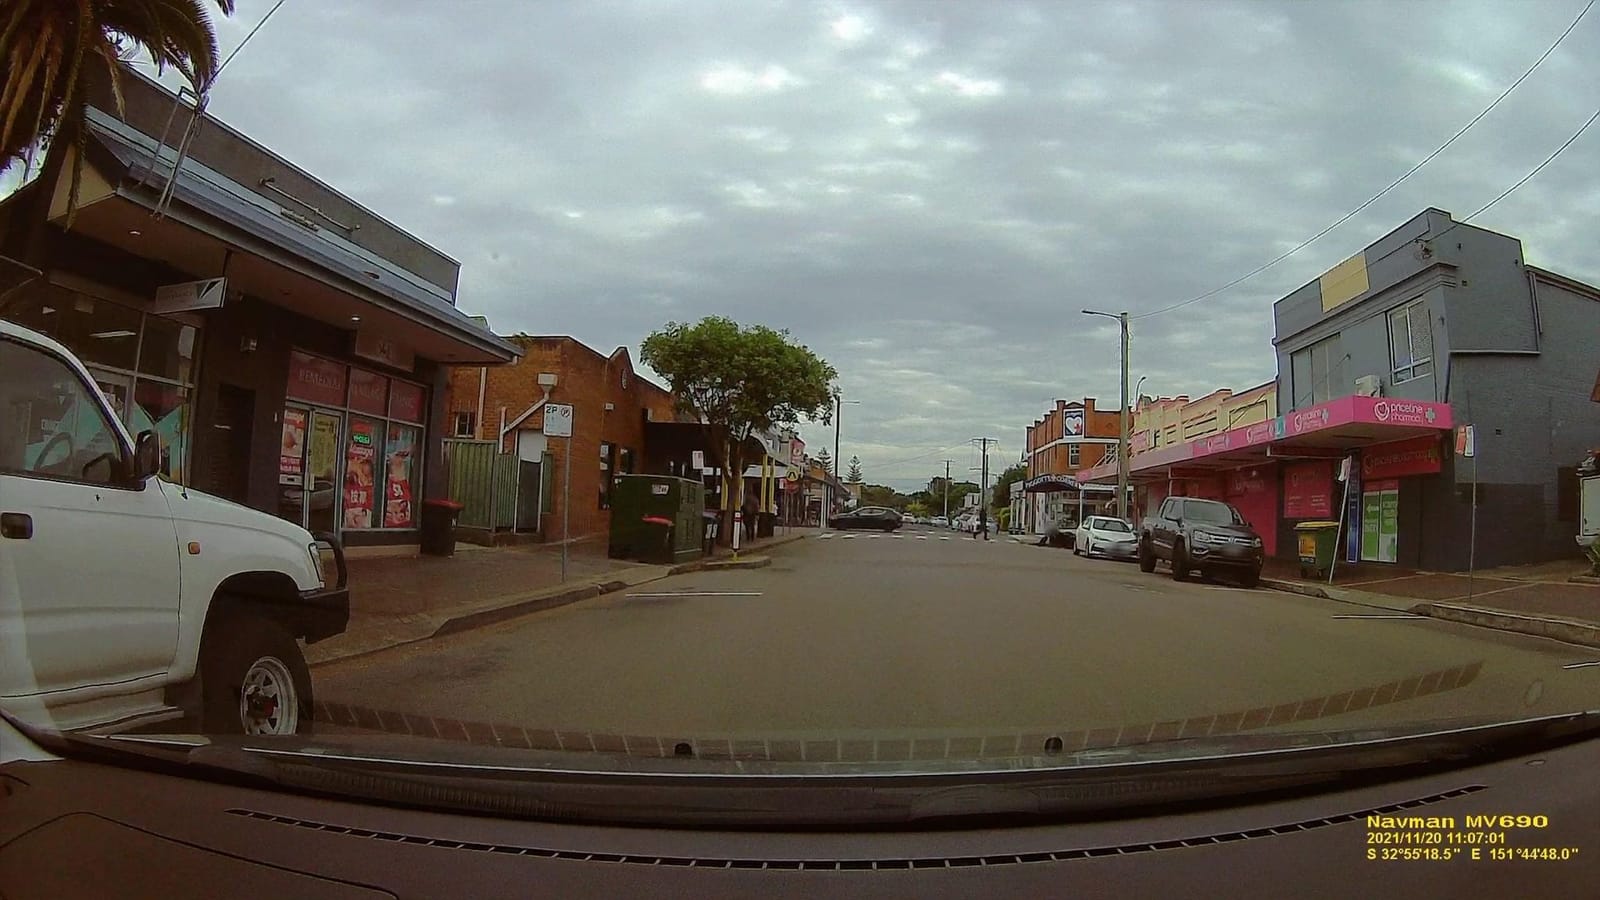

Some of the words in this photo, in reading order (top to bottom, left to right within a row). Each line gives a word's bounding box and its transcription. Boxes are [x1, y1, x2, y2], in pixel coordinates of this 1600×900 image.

[546, 405, 558, 414] 2P
[1390, 402, 1423, 414] priceline
[1390, 413, 1424, 424] pharmacy
